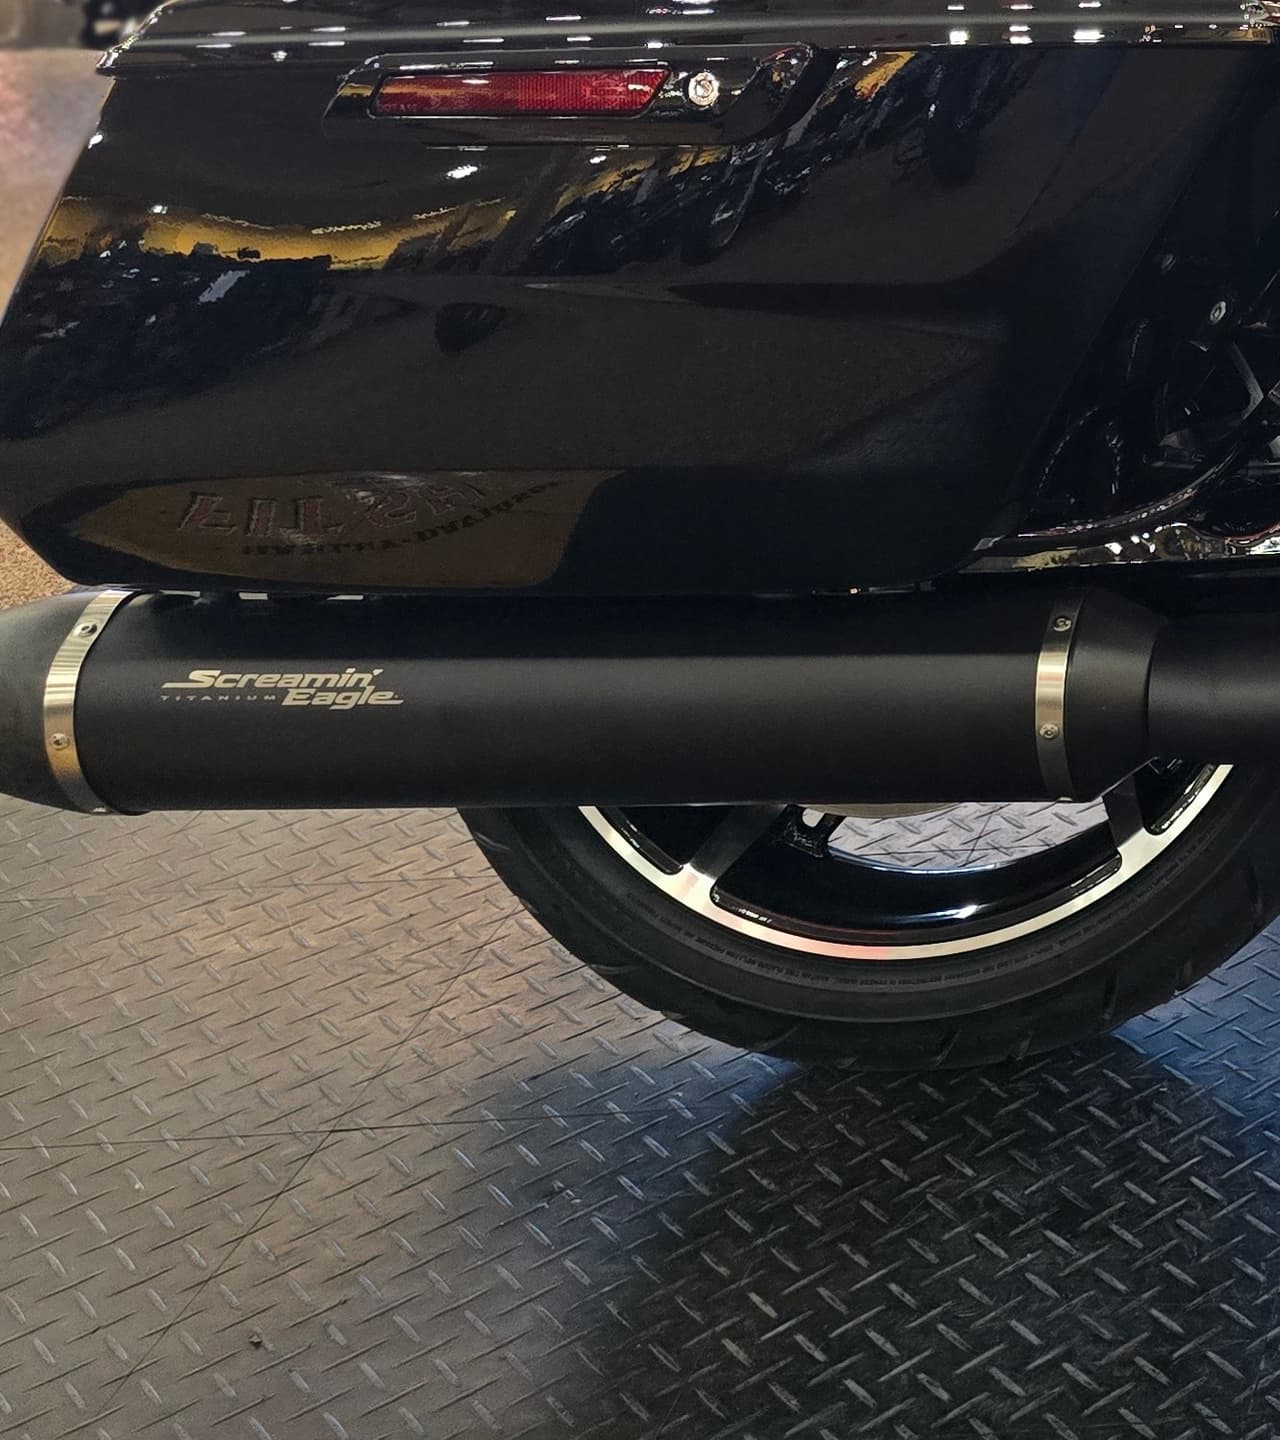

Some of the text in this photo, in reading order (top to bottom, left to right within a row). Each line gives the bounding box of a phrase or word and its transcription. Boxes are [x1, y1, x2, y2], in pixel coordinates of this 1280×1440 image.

[161, 667, 385, 690] Screamin'
[160, 694, 277, 702] TITANIUM
[281, 685, 404, 711] Eagle
